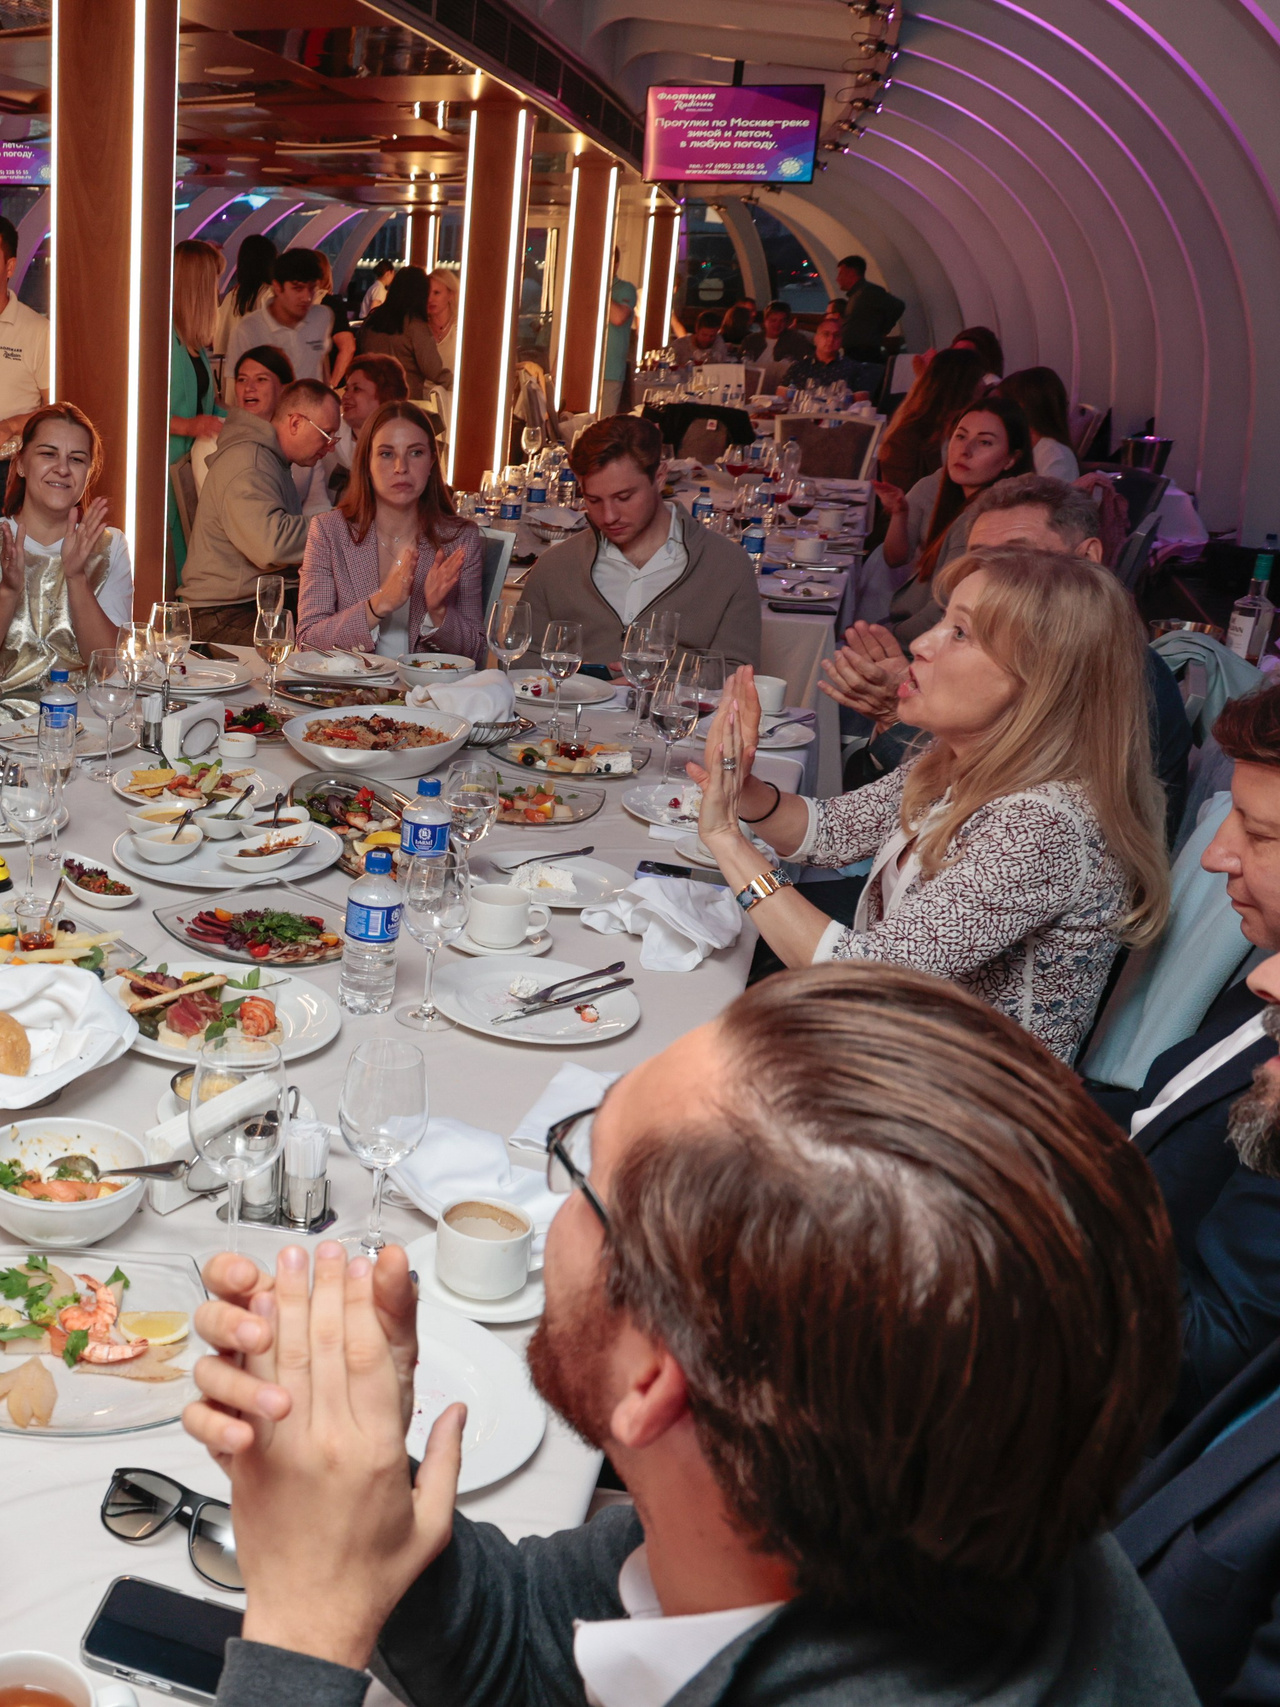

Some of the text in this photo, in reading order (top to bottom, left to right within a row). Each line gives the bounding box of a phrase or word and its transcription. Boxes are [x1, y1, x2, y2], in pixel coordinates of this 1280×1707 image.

[655, 117, 710, 129] Прогулки
[730, 117, 810, 129] Москве-реке
[687, 129, 773, 139] зимой и летом,
[680, 139, 778, 150] в любую погоду.
